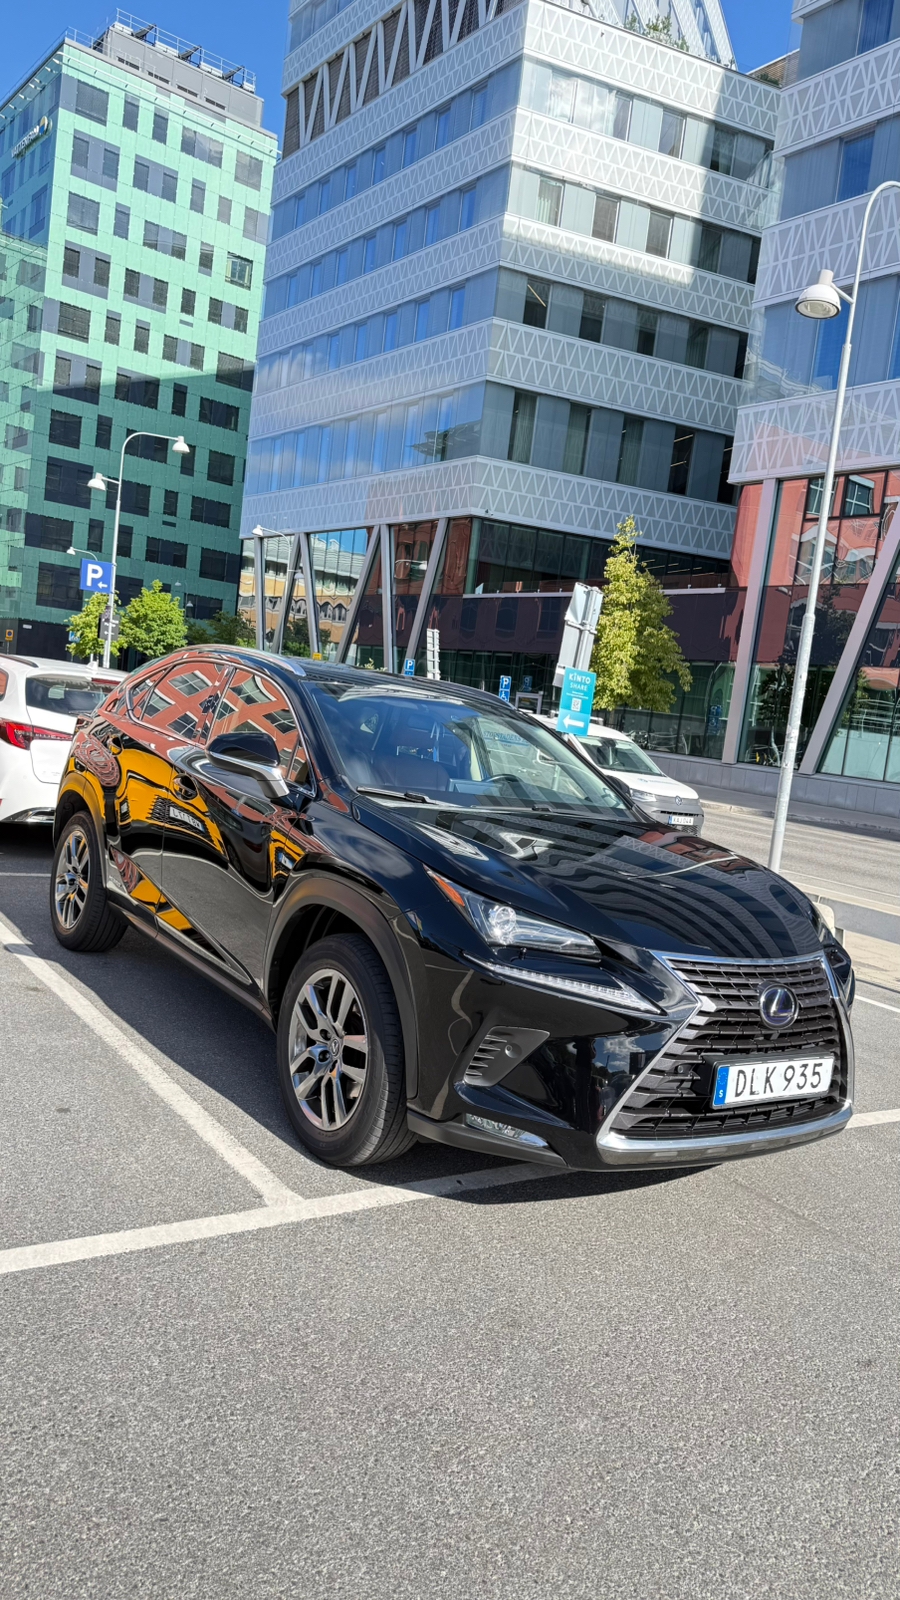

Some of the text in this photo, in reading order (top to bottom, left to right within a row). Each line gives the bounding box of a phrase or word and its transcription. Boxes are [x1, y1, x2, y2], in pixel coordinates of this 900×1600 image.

[86, 563, 103, 587] P
[407, 660, 413, 670] P
[503, 678, 509, 688] P
[569, 682, 588, 691] SHARE
[734, 1062, 823, 1098] DLK 935
[718, 1090, 723, 1098] S
